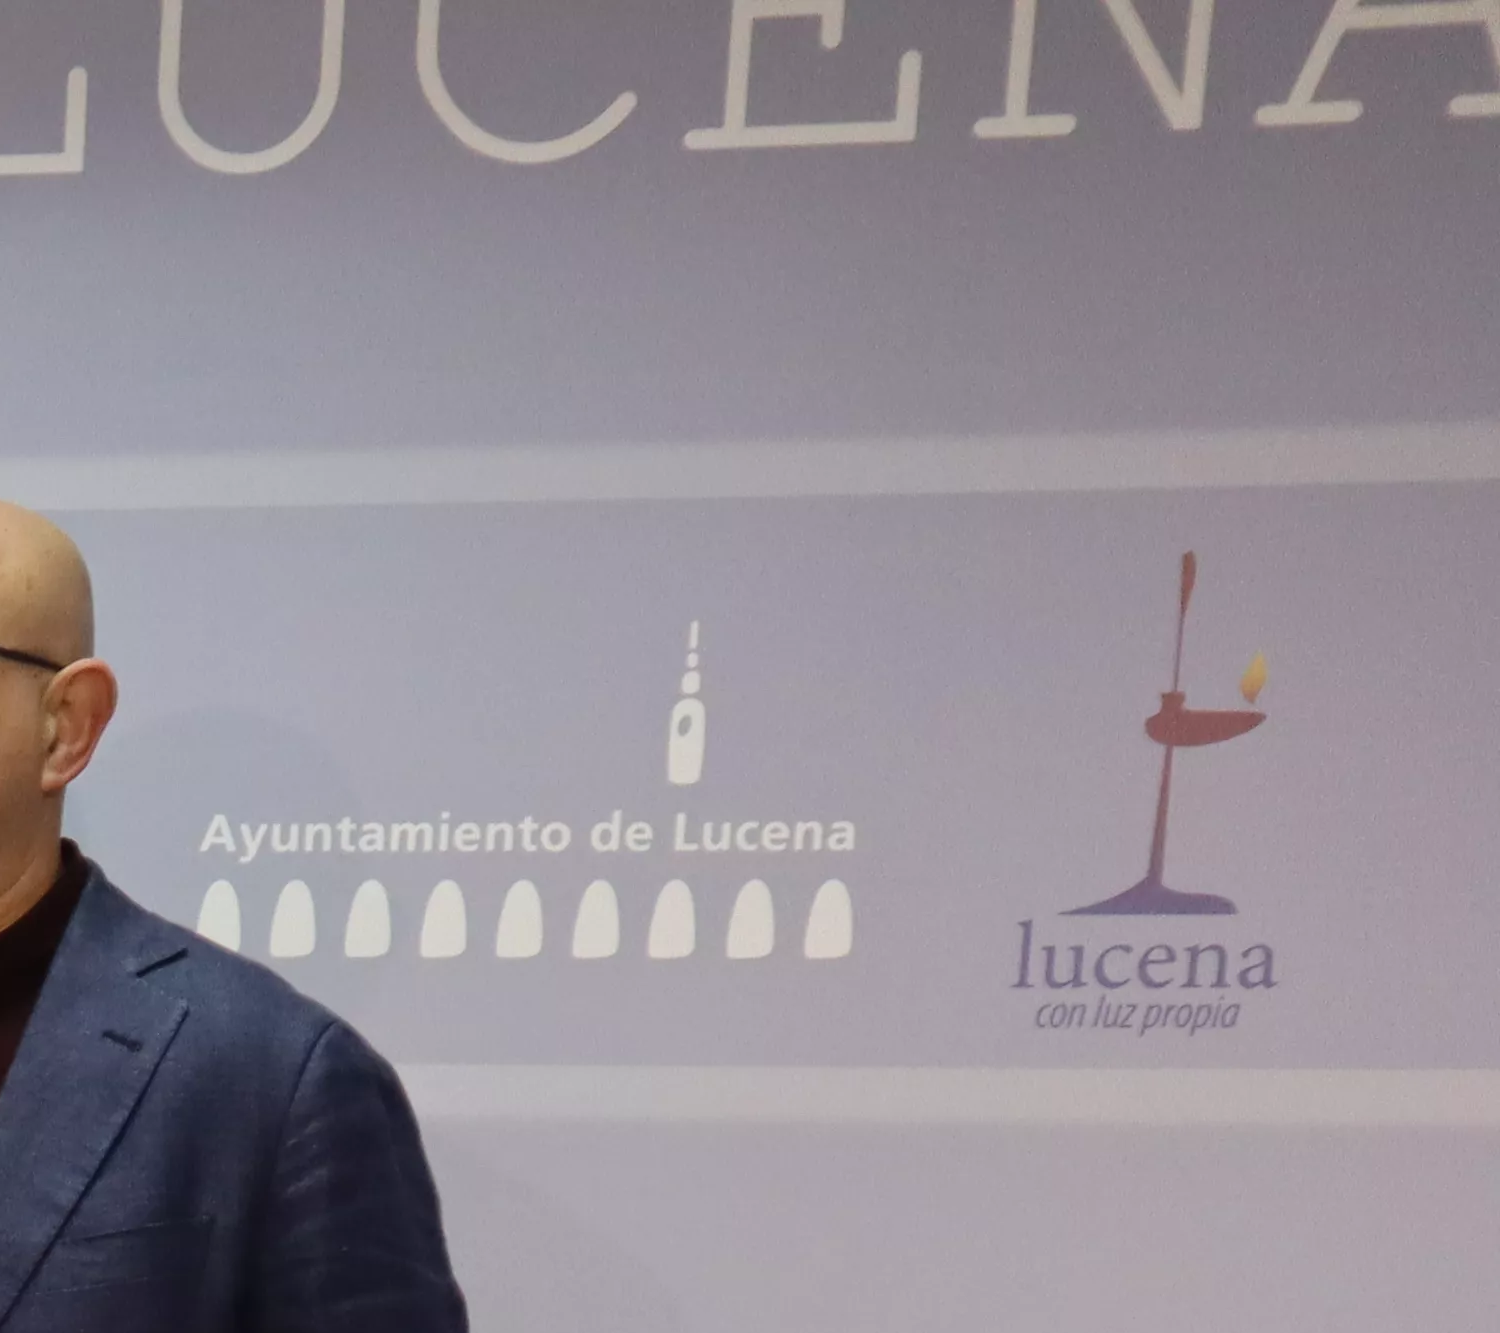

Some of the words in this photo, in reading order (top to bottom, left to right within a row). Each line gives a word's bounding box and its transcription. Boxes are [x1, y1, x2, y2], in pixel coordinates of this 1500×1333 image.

[200, 811, 571, 864] Ayuntamiento
[590, 811, 653, 853] de
[674, 812, 857, 853] Lucena
[1010, 919, 1279, 989] lucena
[1035, 1001, 1087, 1029] con
[1091, 994, 1137, 1029] luz
[1139, 996, 1241, 1037] propia
